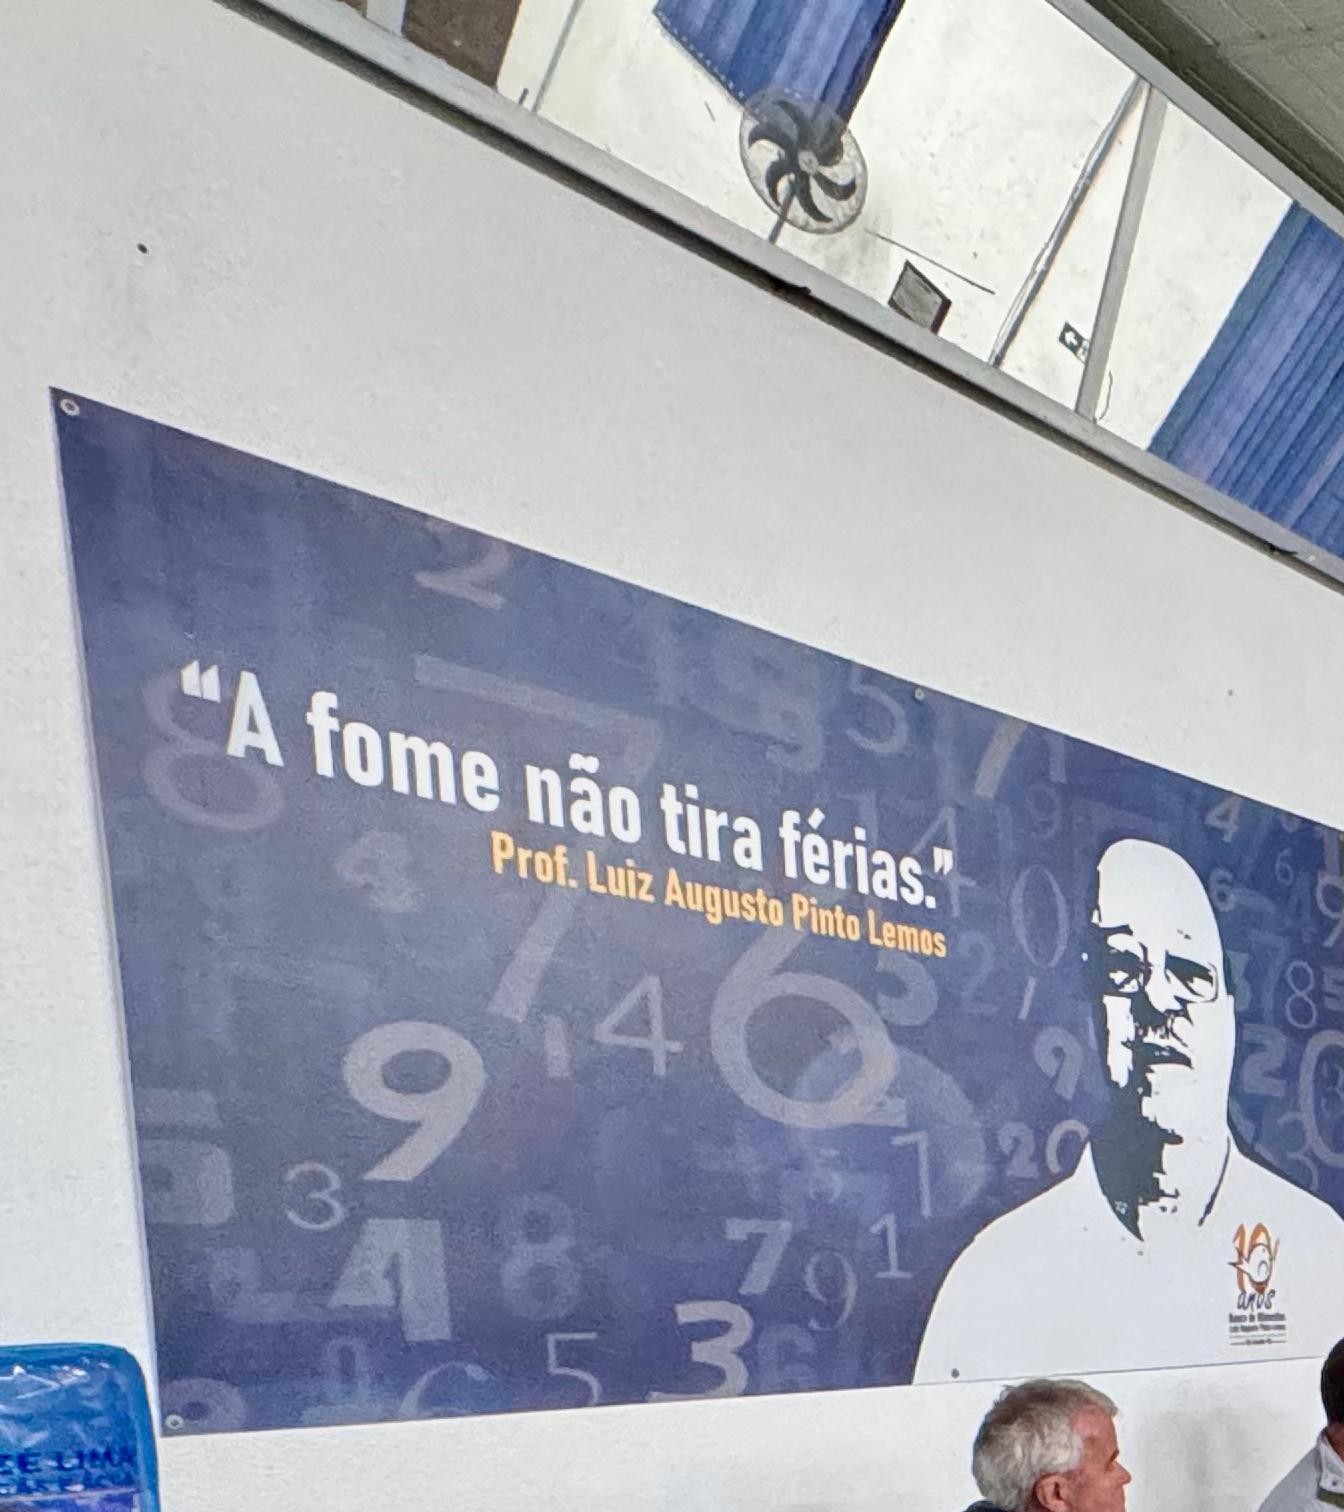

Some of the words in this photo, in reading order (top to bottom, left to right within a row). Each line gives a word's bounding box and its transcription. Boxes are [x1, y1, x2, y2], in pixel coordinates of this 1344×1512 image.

[306, 692, 499, 812] fome
[526, 753, 643, 842] não
[661, 783, 762, 870] tira
[491, 829, 576, 891] Prof.
[585, 856, 656, 902] Luiz
[665, 868, 783, 925] Augusto
[792, 894, 861, 941] Pinto
[868, 909, 947, 958] Lemos
[343, 1021, 486, 1181] 9
